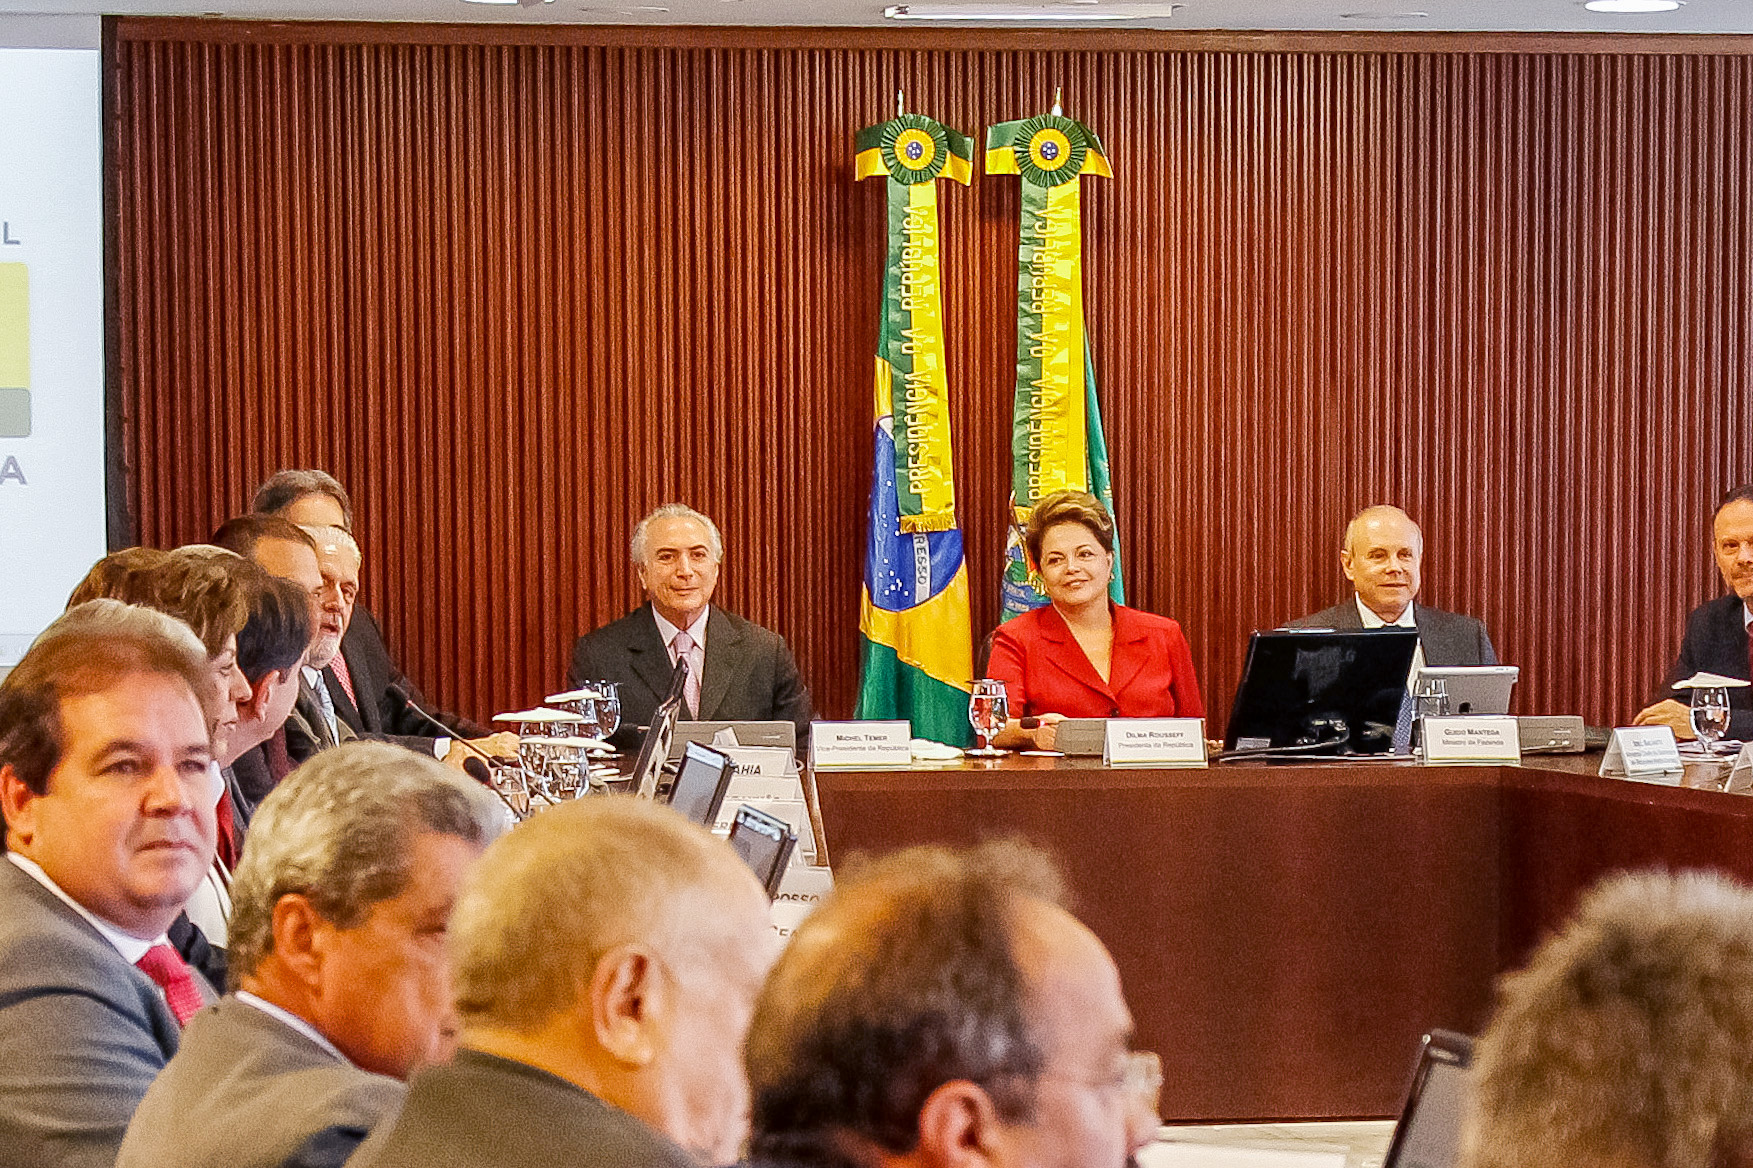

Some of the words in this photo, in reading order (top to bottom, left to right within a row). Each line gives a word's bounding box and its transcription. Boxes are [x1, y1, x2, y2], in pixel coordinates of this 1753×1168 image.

[901, 327, 925, 354] DA
[914, 534, 928, 585] RESSO
[733, 764, 762, 776] AHIA
